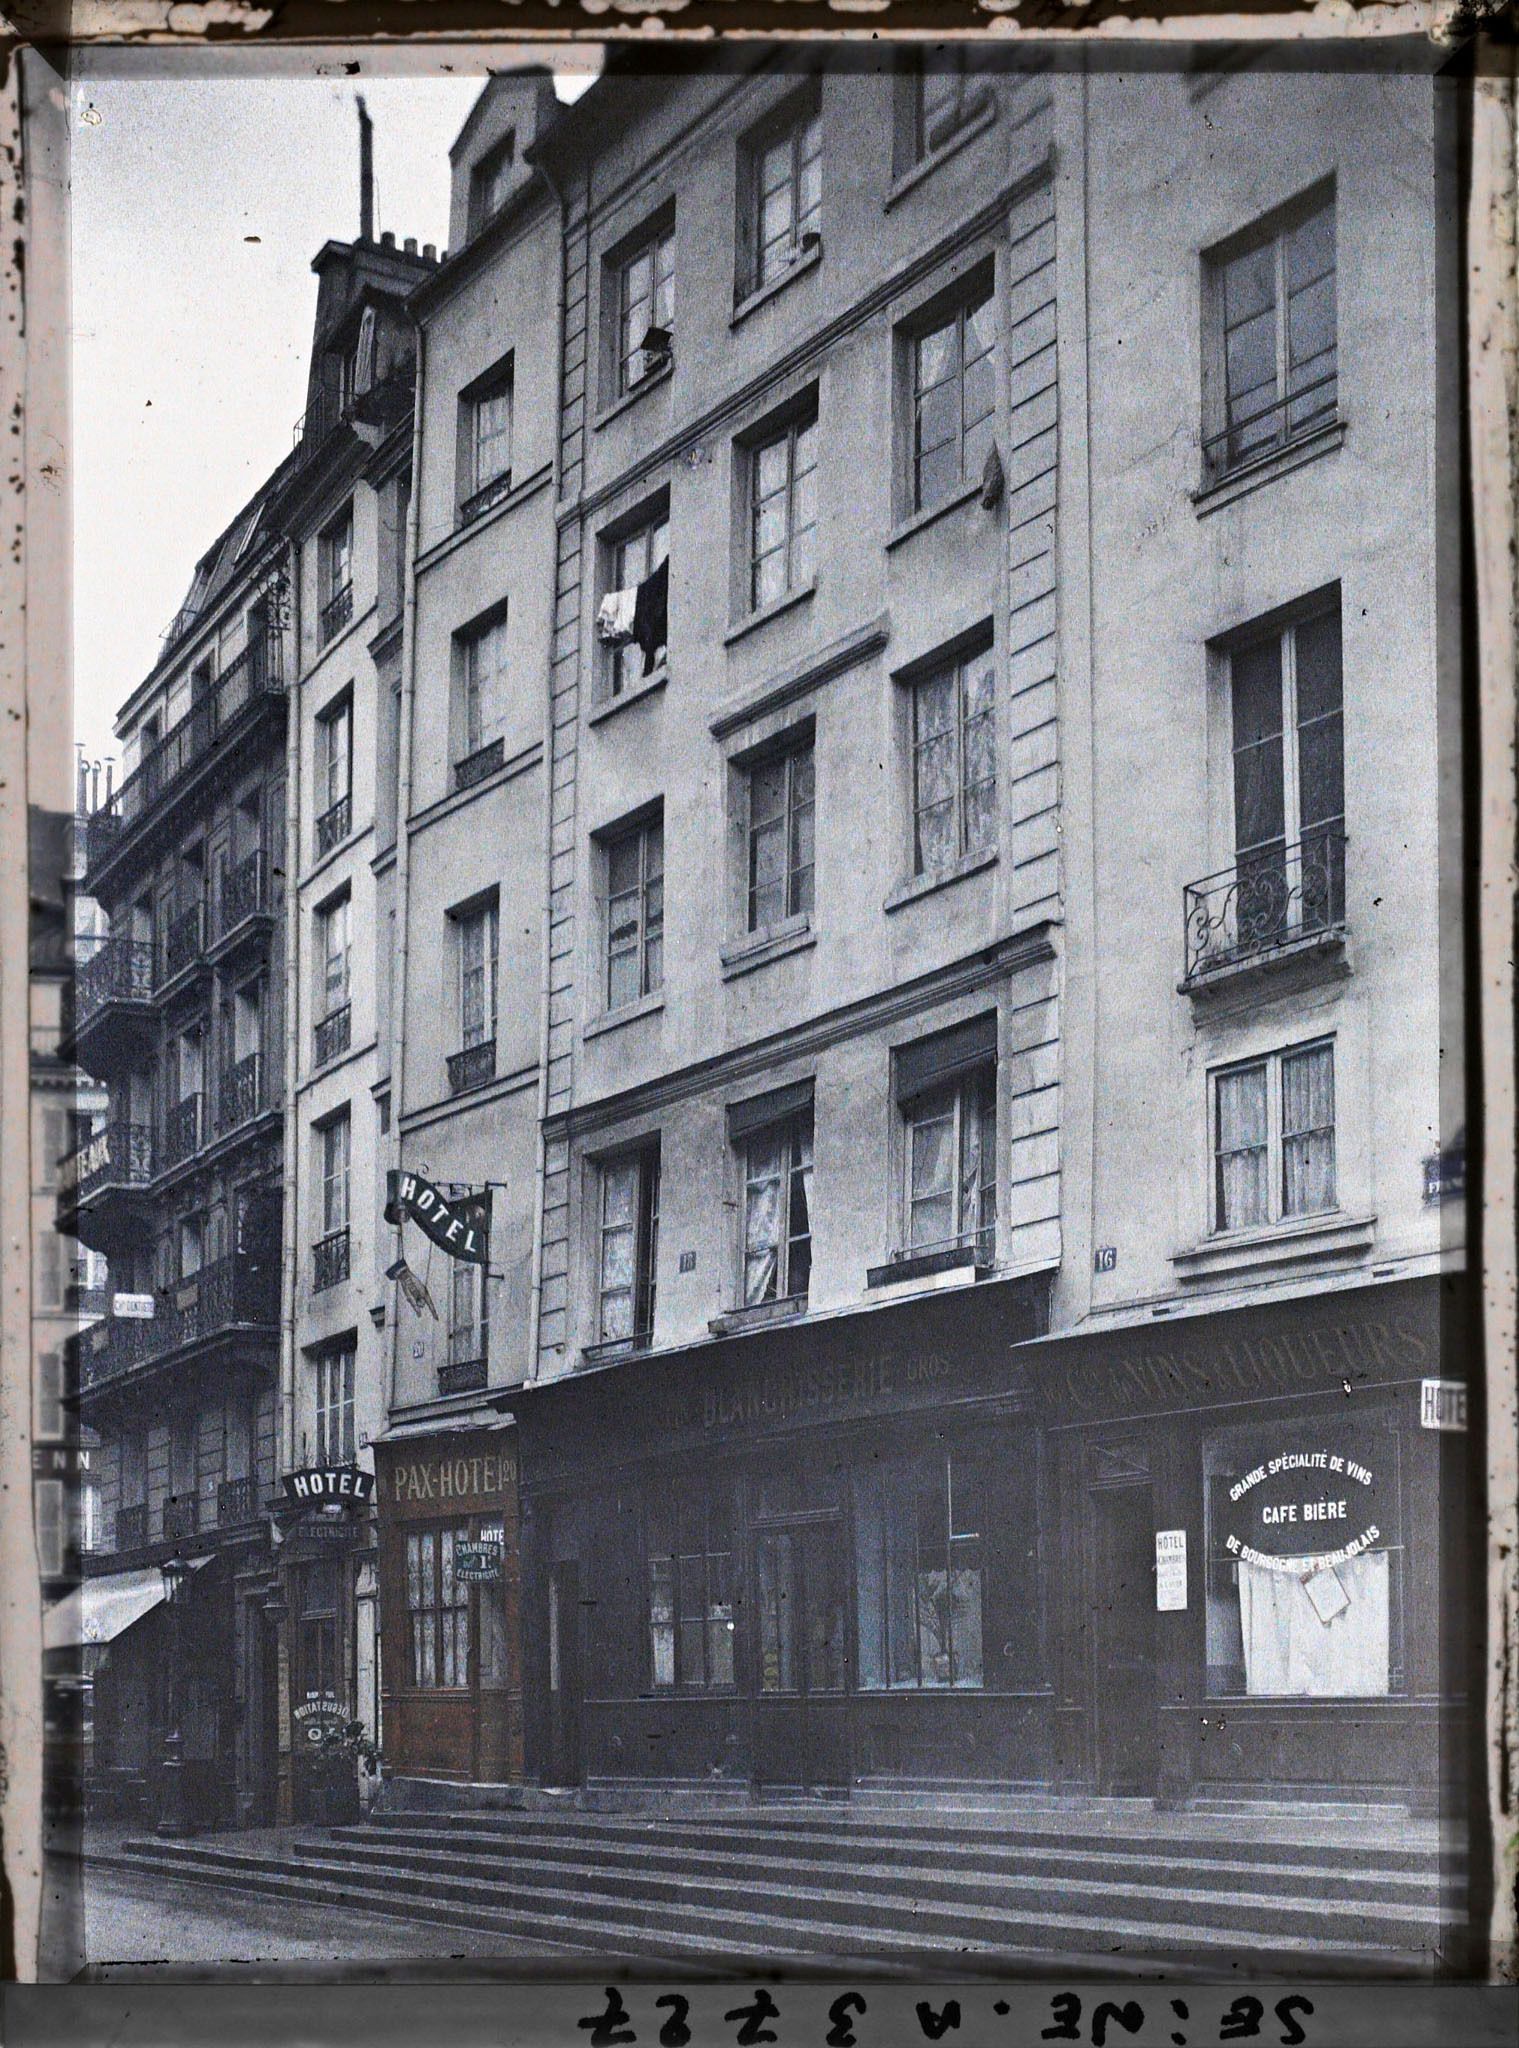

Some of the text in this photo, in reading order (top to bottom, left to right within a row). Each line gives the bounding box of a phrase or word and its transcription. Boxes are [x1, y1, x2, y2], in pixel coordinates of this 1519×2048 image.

[400, 1176, 477, 1254] HOTEL
[293, 1471, 366, 1499] HOTEL
[1229, 1449, 1373, 1502] GRANDE SPÉCIALITÉ DE VINS
[1263, 1496, 1347, 1524] CAFE BIÈRE
[455, 1541, 498, 1557] CHAMBRES
[1225, 1534, 1242, 1555] DE
[1318, 1525, 1380, 1570] BEAUJOLAIS
